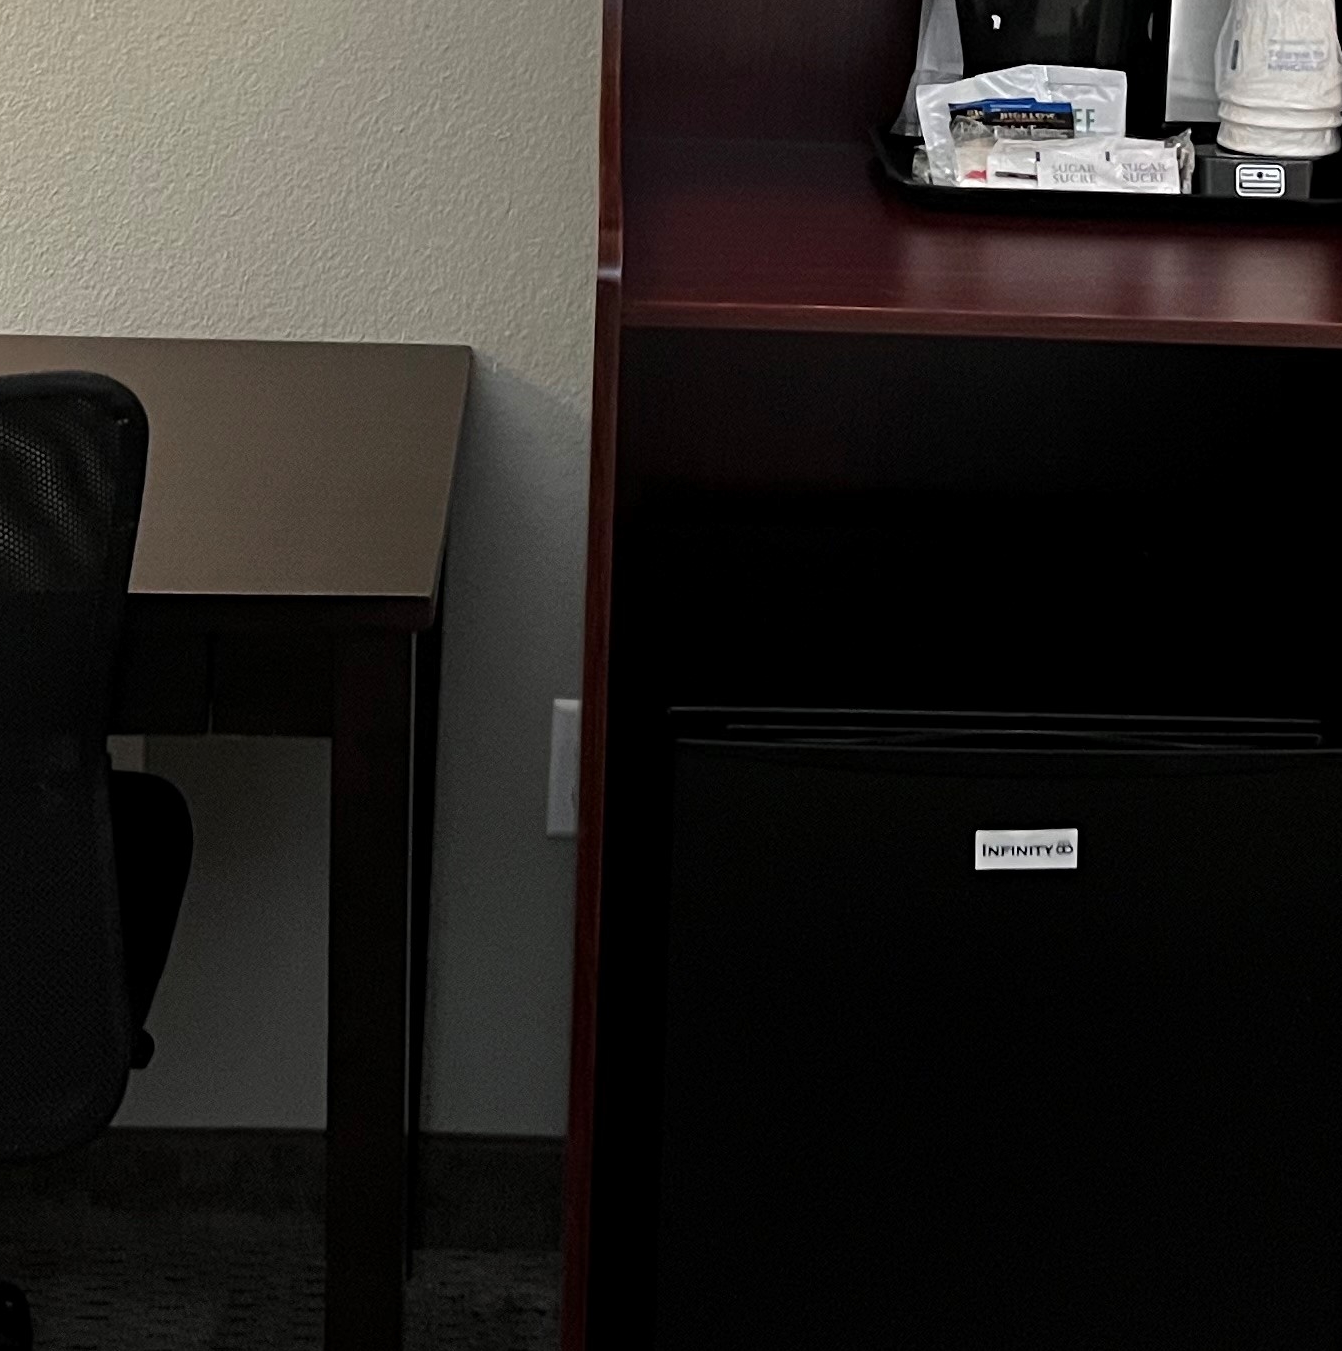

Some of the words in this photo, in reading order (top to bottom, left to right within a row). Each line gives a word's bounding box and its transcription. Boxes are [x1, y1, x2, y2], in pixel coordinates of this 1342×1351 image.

[1051, 163, 1097, 174] SUGAR
[1121, 162, 1168, 173] SUGAR
[1052, 173, 1097, 184] SUCRE
[982, 843, 1054, 857] INFINITY
